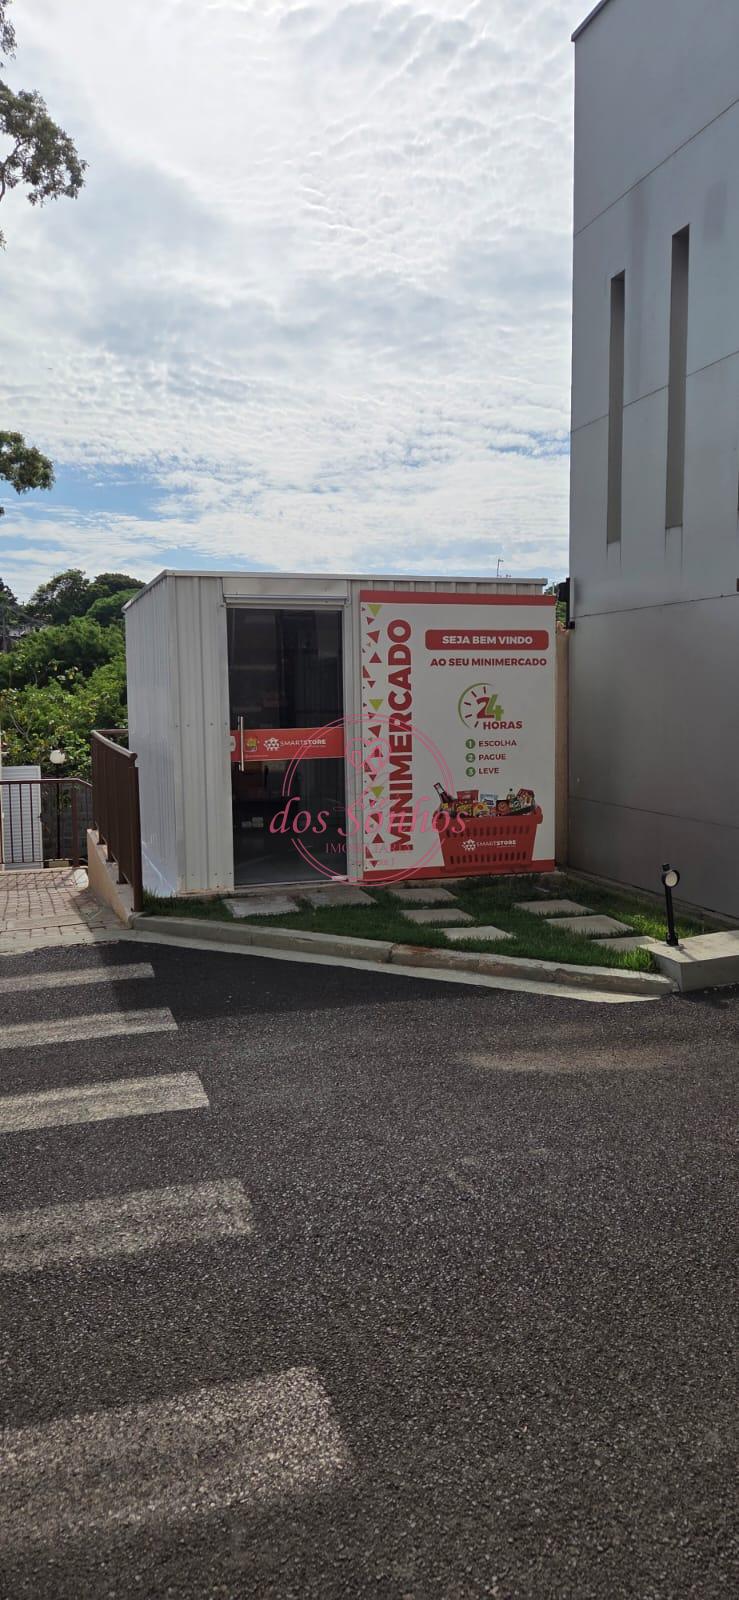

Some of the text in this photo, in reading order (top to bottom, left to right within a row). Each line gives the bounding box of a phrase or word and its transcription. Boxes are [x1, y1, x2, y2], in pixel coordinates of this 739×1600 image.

[442, 635, 533, 645] SEJA BEM VINDO
[430, 658, 547, 667] AO SEU MINIMERCADO
[476, 694, 504, 721] 24
[483, 721, 523, 730] HORAS
[387, 619, 413, 852] MINIMERCADO
[478, 739, 517, 747] ESCOLHA
[478, 753, 506, 761] PAGUE
[478, 767, 500, 775] LEVE
